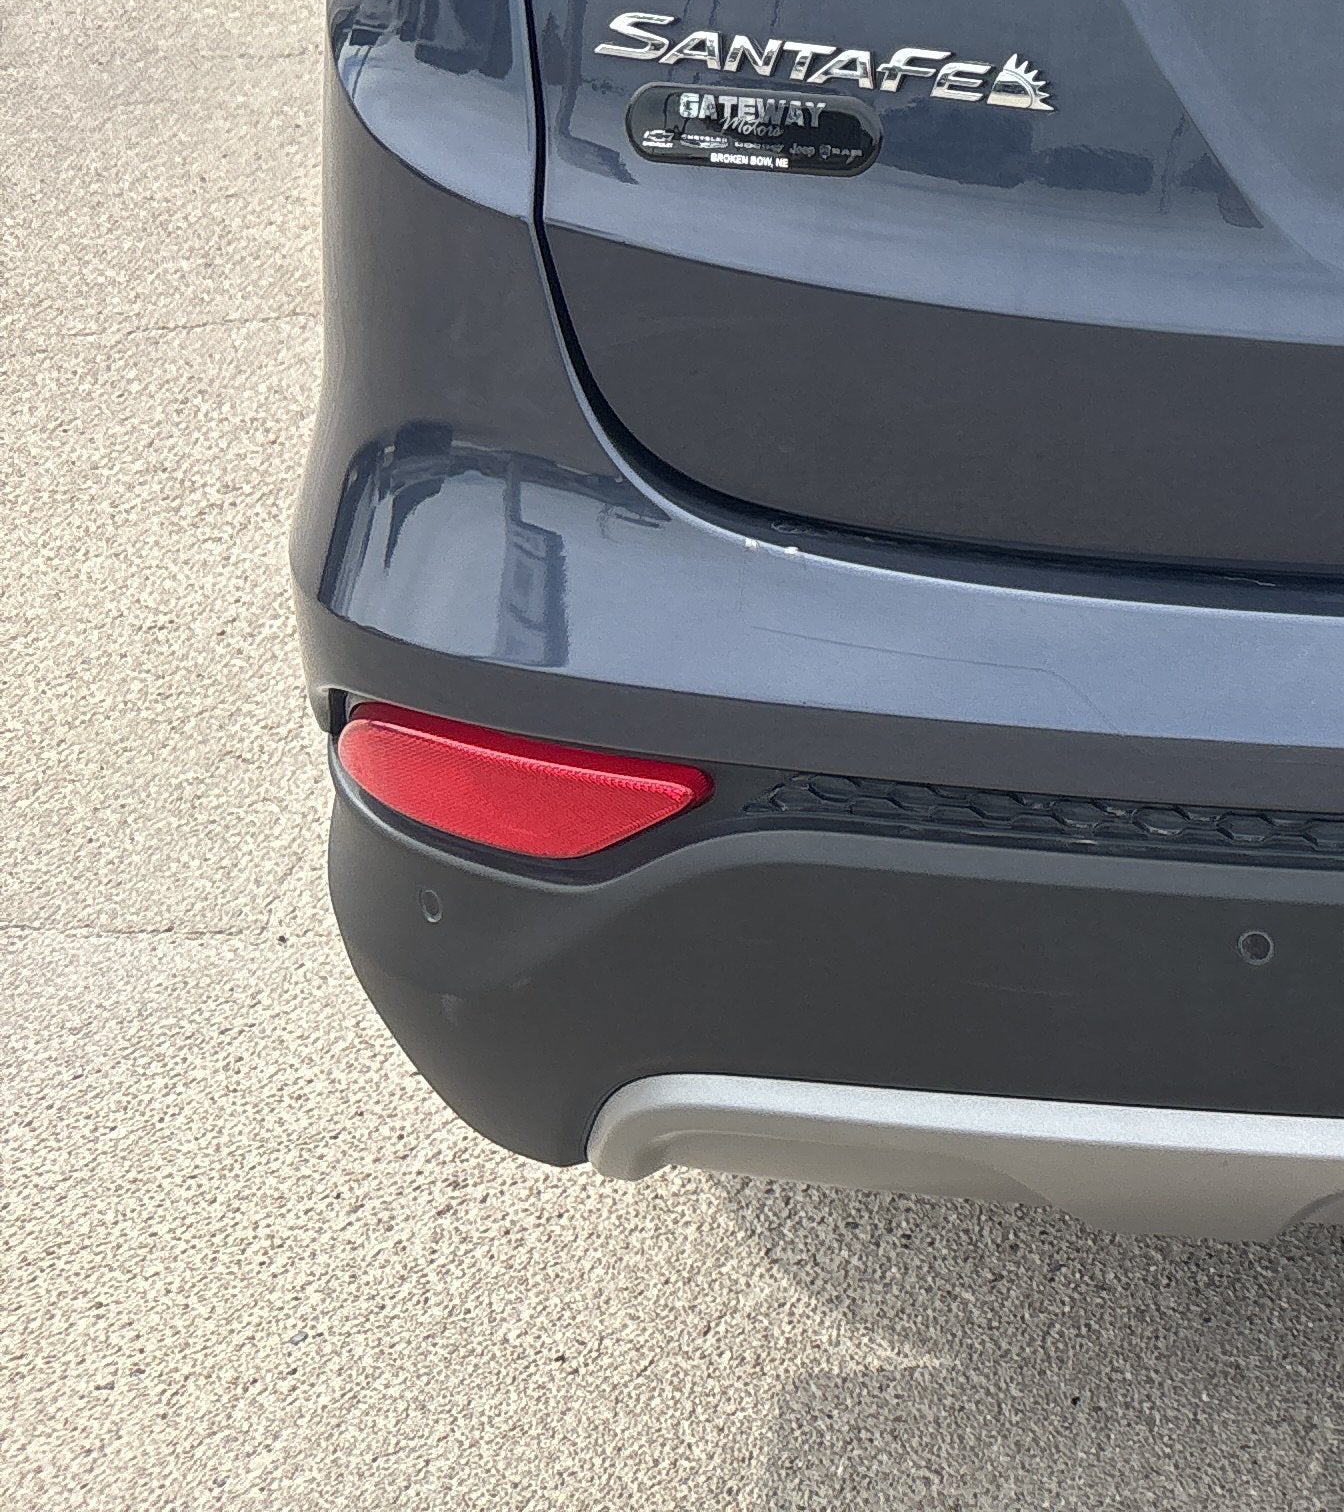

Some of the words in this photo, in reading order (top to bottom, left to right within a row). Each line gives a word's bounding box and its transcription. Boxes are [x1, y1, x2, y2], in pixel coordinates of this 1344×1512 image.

[679, 93, 826, 128] GATEWAY
[721, 115, 785, 138] Motors
[710, 152, 749, 166] BROKEN
[749, 155, 774, 169] BOW,
[775, 157, 790, 168] NE
